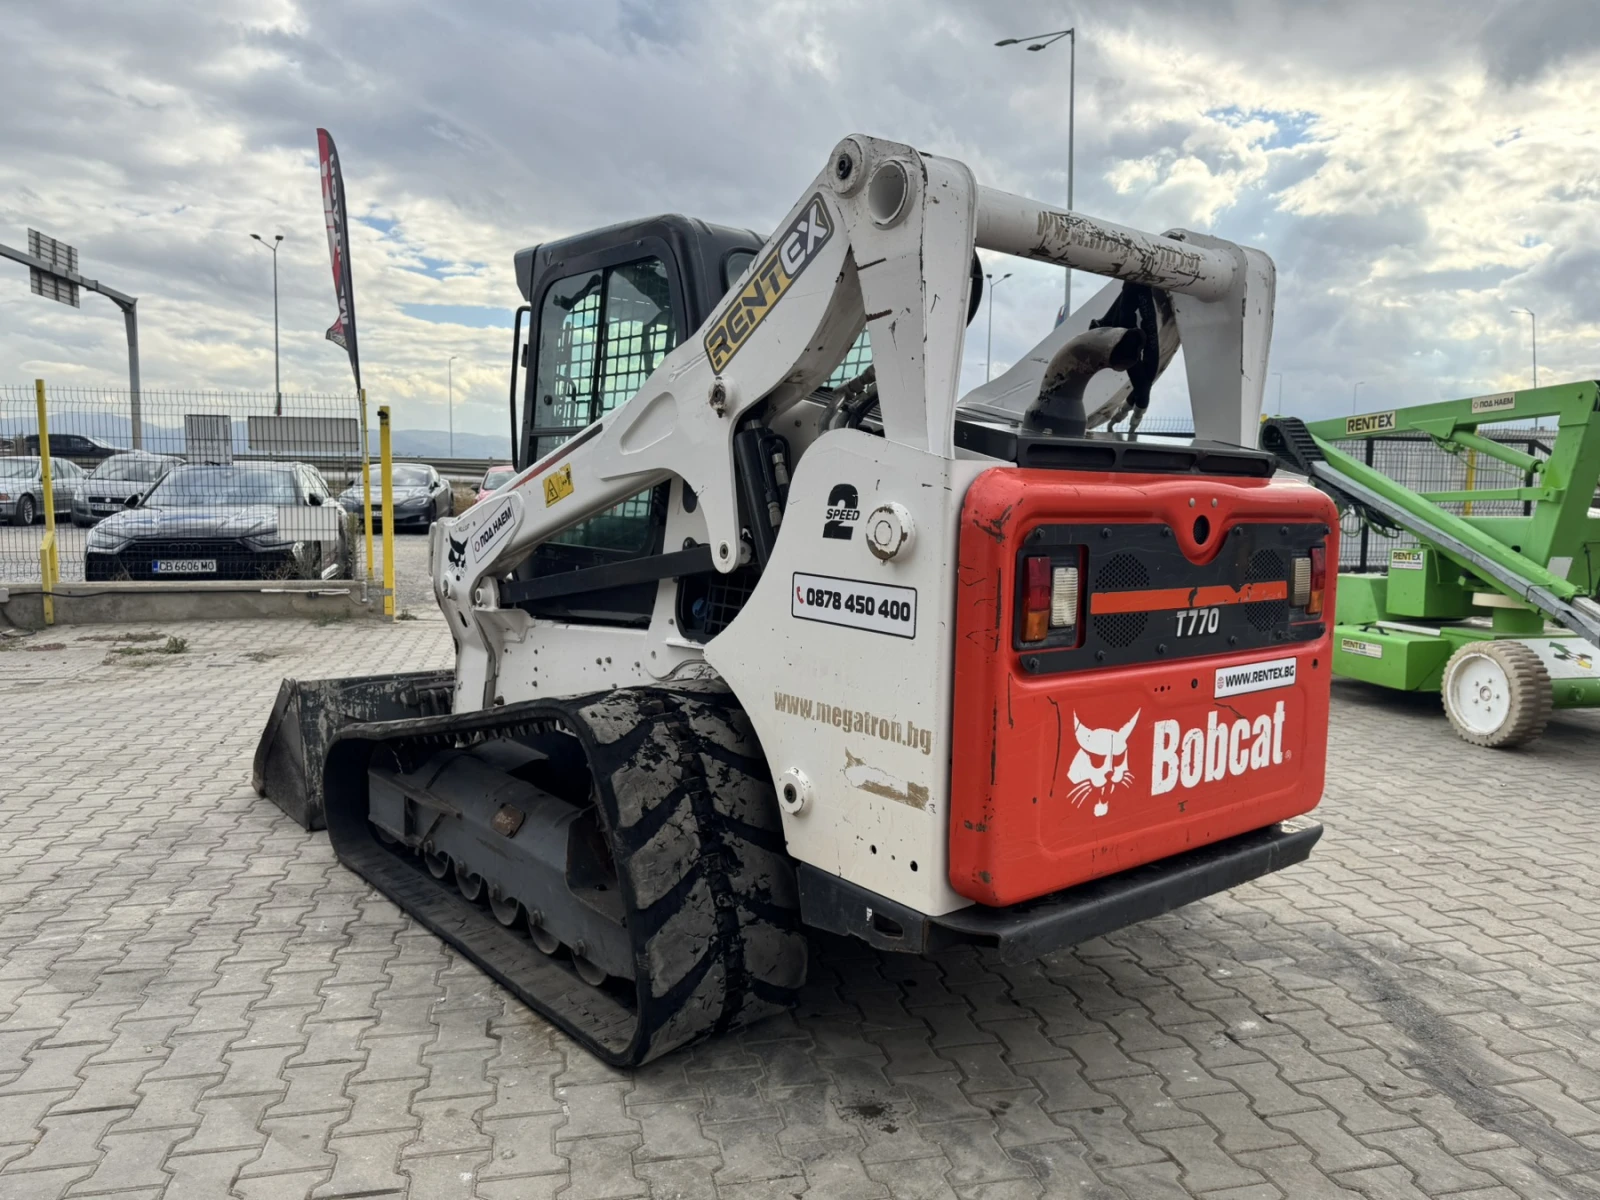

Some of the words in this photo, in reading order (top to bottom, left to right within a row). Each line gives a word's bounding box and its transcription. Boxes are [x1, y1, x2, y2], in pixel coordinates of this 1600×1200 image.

[707, 203, 829, 366] RENTEX
[1479, 400, 1493, 408] ПОД
[1494, 397, 1514, 407] НАЕМ
[1347, 413, 1394, 433] RENTEX
[479, 527, 495, 548] ПОД
[492, 506, 513, 534] НАЕМ
[826, 508, 860, 521] SPEED
[159, 561, 173, 571] CB
[174, 561, 199, 571] 6606
[1393, 551, 1422, 561] RENTEX
[806, 587, 842, 611] 0878
[844, 594, 875, 617] 450
[878, 599, 911, 622] 400
[1176, 607, 1220, 638] T770
[1225, 665, 1295, 688] WWW.RENTEX.BG
[774, 691, 932, 756] www.megatron.bg
[1151, 700, 1286, 796] Bobcat
